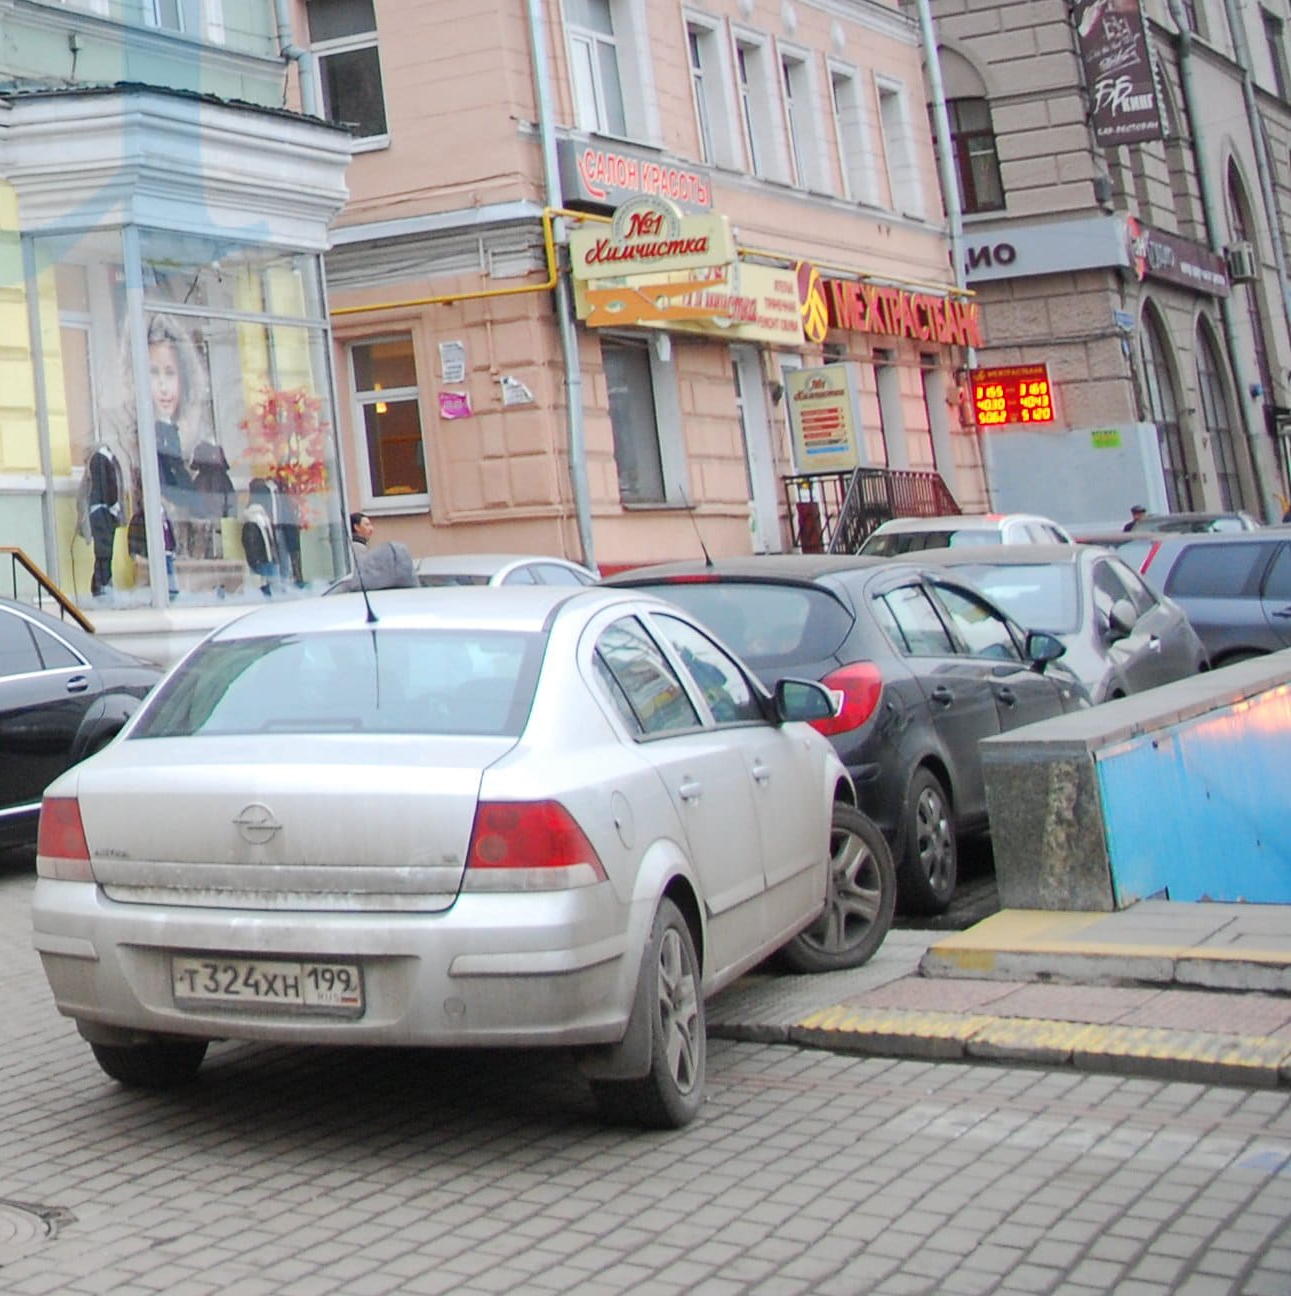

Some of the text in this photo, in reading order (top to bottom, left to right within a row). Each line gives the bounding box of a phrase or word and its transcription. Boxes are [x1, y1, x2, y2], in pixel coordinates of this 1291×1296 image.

[583, 147, 711, 205] САЛОН КРАСОТЫ
[624, 210, 665, 240] №1
[584, 237, 708, 265] Химчистка
[964, 242, 1017, 276] ИО
